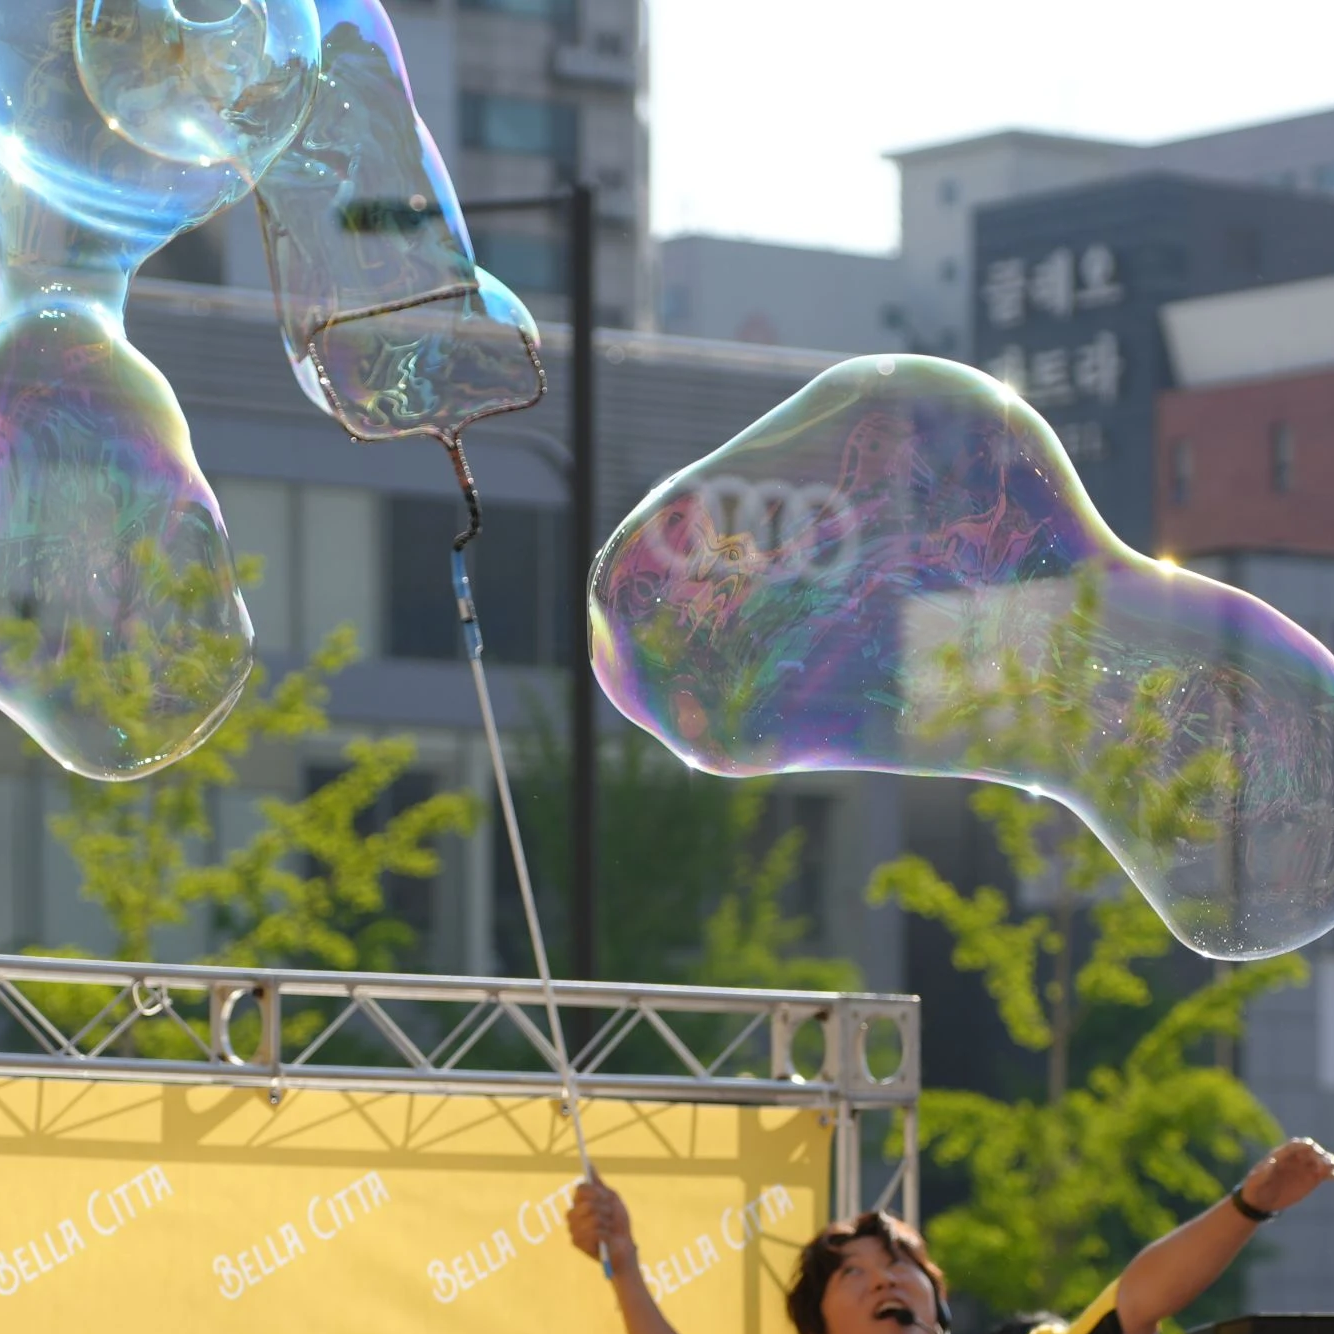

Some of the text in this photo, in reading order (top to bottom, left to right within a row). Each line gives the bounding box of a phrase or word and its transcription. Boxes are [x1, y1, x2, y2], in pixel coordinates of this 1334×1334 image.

[87, 1164, 174, 1236] CITTA
[212, 1170, 391, 1300] BELLA CITTA
[427, 1176, 587, 1304] BELLA CITT
[720, 1183, 795, 1252] CITTA
